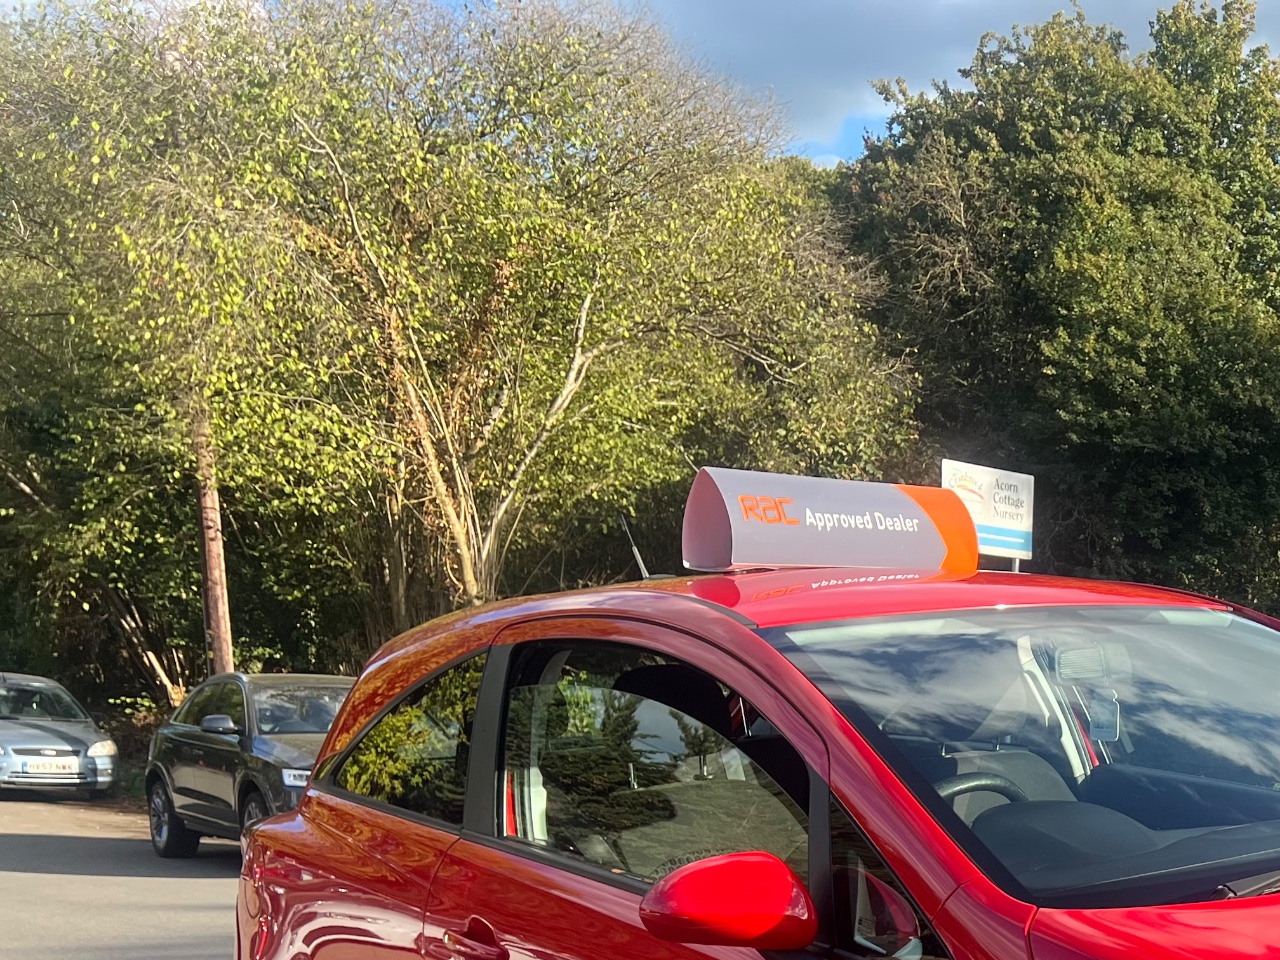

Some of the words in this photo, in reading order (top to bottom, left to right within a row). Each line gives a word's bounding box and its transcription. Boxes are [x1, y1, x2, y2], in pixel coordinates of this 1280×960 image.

[993, 478, 1019, 493] Acorn
[993, 491, 1025, 509] Cottage
[805, 507, 873, 532] Approved
[874, 511, 919, 532] Dealer
[993, 505, 1024, 523] Nursery
